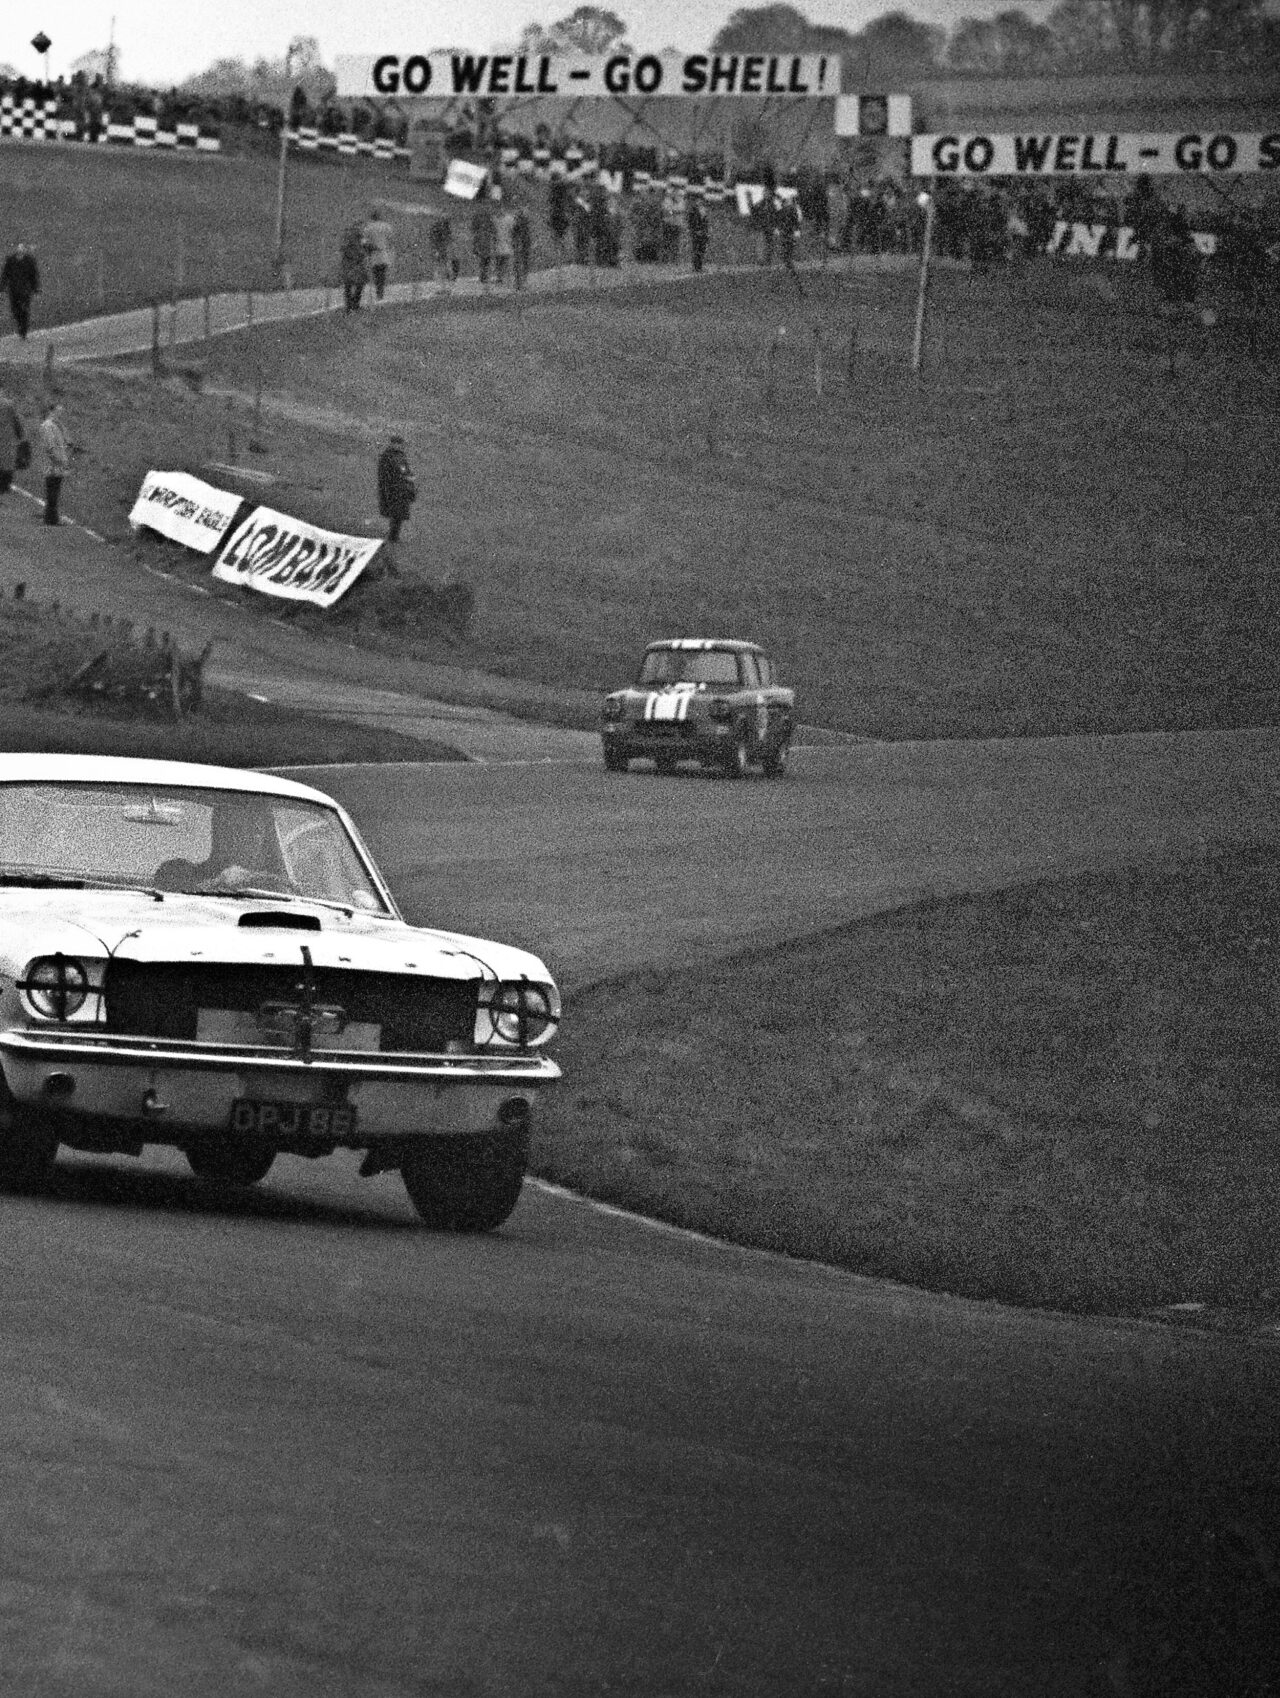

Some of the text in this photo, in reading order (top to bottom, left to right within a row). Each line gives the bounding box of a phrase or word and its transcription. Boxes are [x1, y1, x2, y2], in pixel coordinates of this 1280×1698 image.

[372, 55, 433, 94] GO
[451, 55, 559, 95] WELL
[604, 55, 664, 94] GO
[682, 55, 828, 94] SHELL!
[931, 136, 995, 173] GO
[1014, 135, 1127, 171] WELL
[1174, 134, 1238, 170] GO
